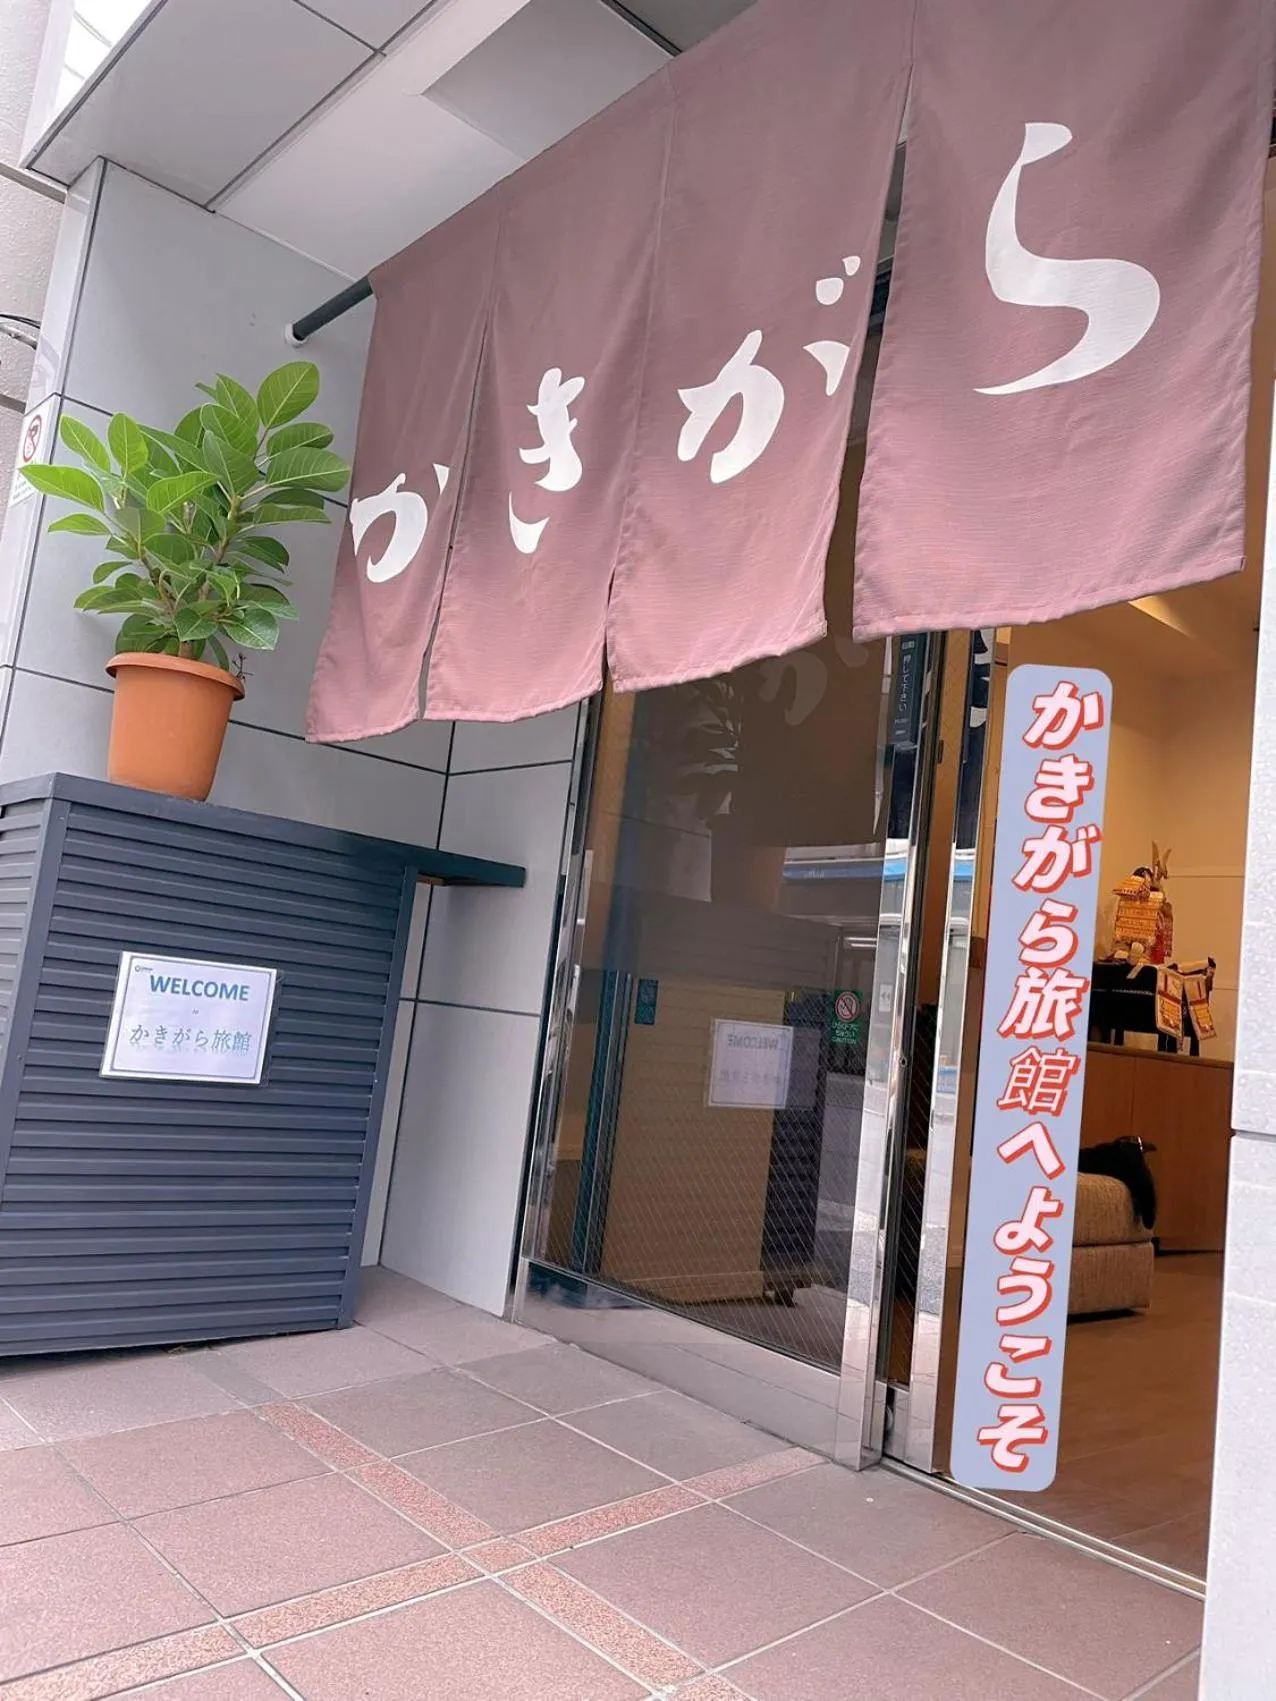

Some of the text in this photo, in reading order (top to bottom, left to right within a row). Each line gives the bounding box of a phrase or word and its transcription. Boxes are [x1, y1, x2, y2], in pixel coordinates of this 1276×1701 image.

[149, 974, 251, 1002] WELCOME
[128, 1023, 253, 1053] かきがら旅館
